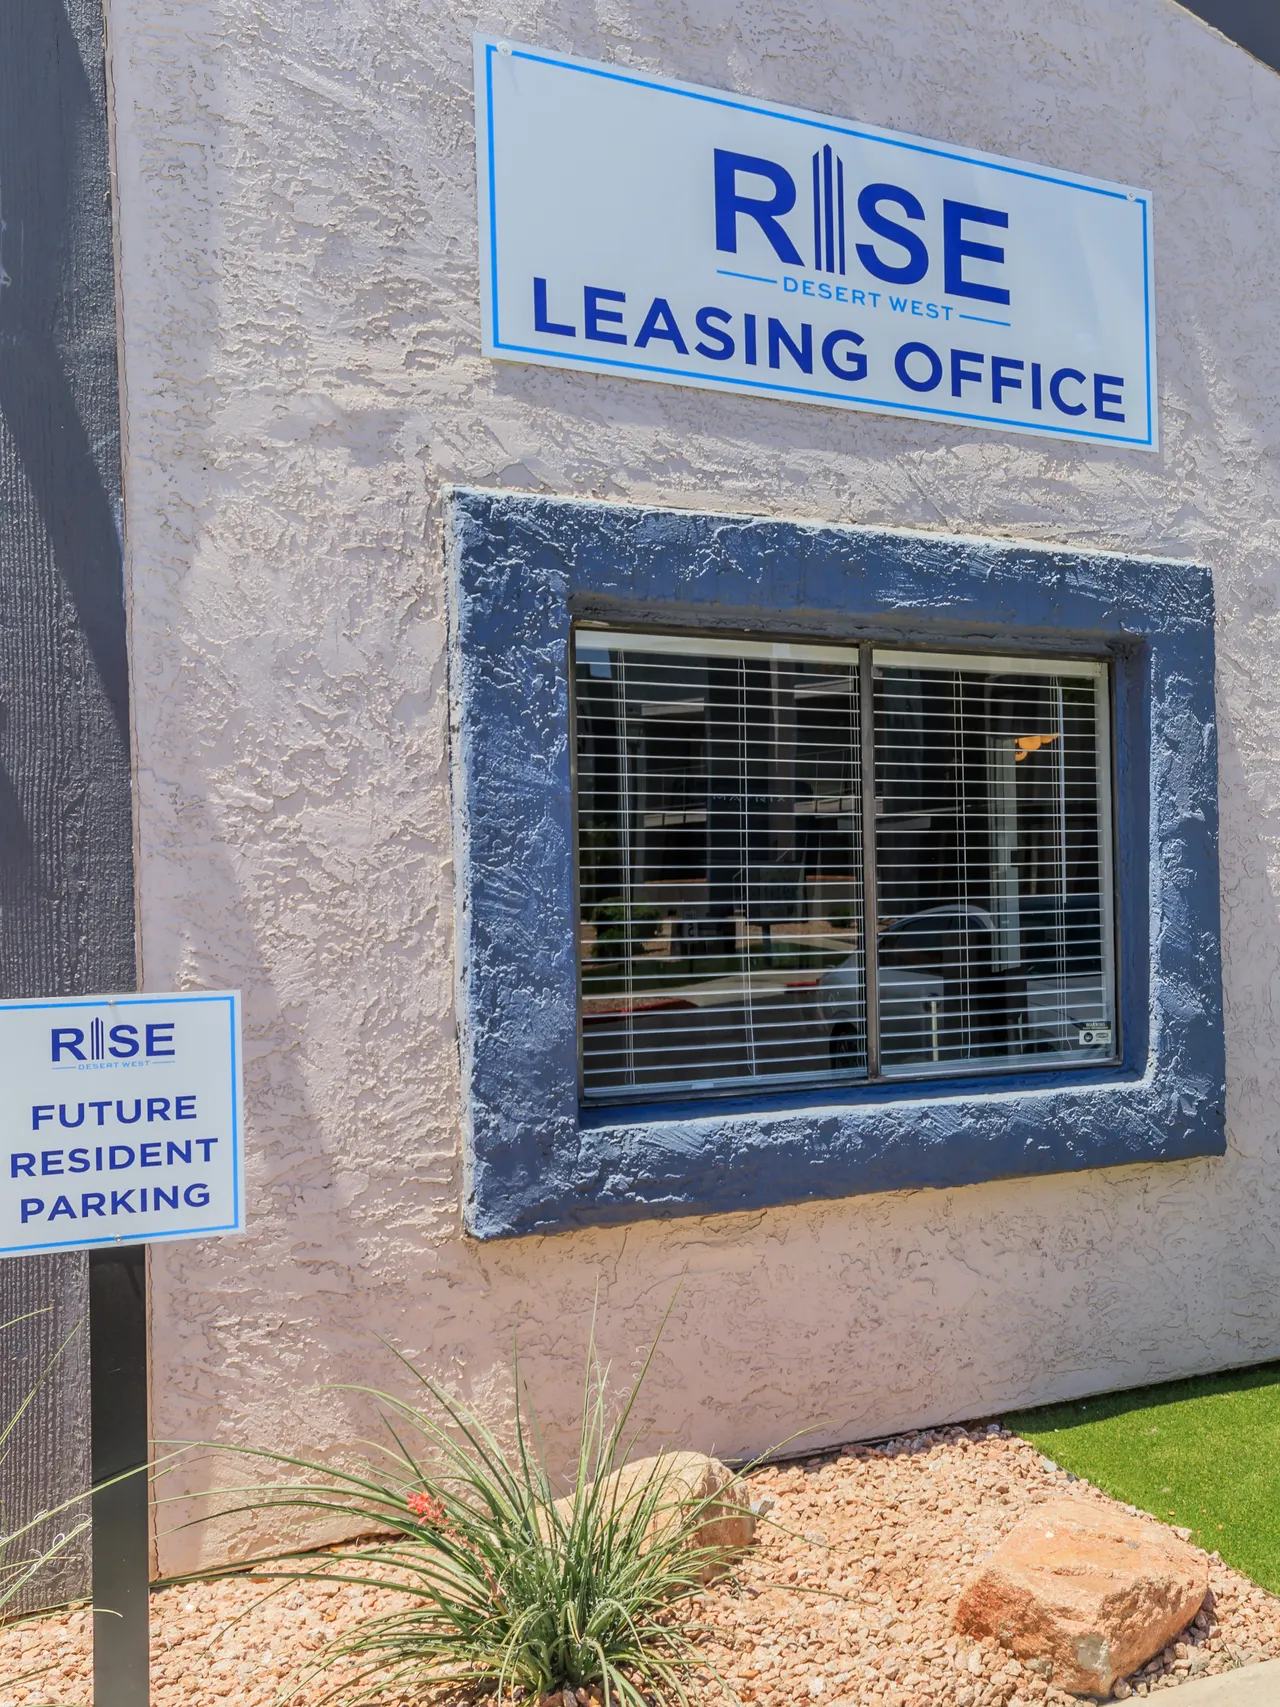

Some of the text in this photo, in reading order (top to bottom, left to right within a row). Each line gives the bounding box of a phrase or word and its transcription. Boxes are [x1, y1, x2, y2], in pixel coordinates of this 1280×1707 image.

[713, 143, 1011, 305] RISE
[783, 277, 955, 321] DESERT WEST
[533, 276, 1126, 424] LEASING OFFICE
[51, 1017, 175, 1062] RISE
[78, 1060, 150, 1070] DESERT WEST
[32, 1095, 197, 1130] FUTURE
[10, 1137, 218, 1178] RESIDENT
[20, 1183, 210, 1223] PARKING
